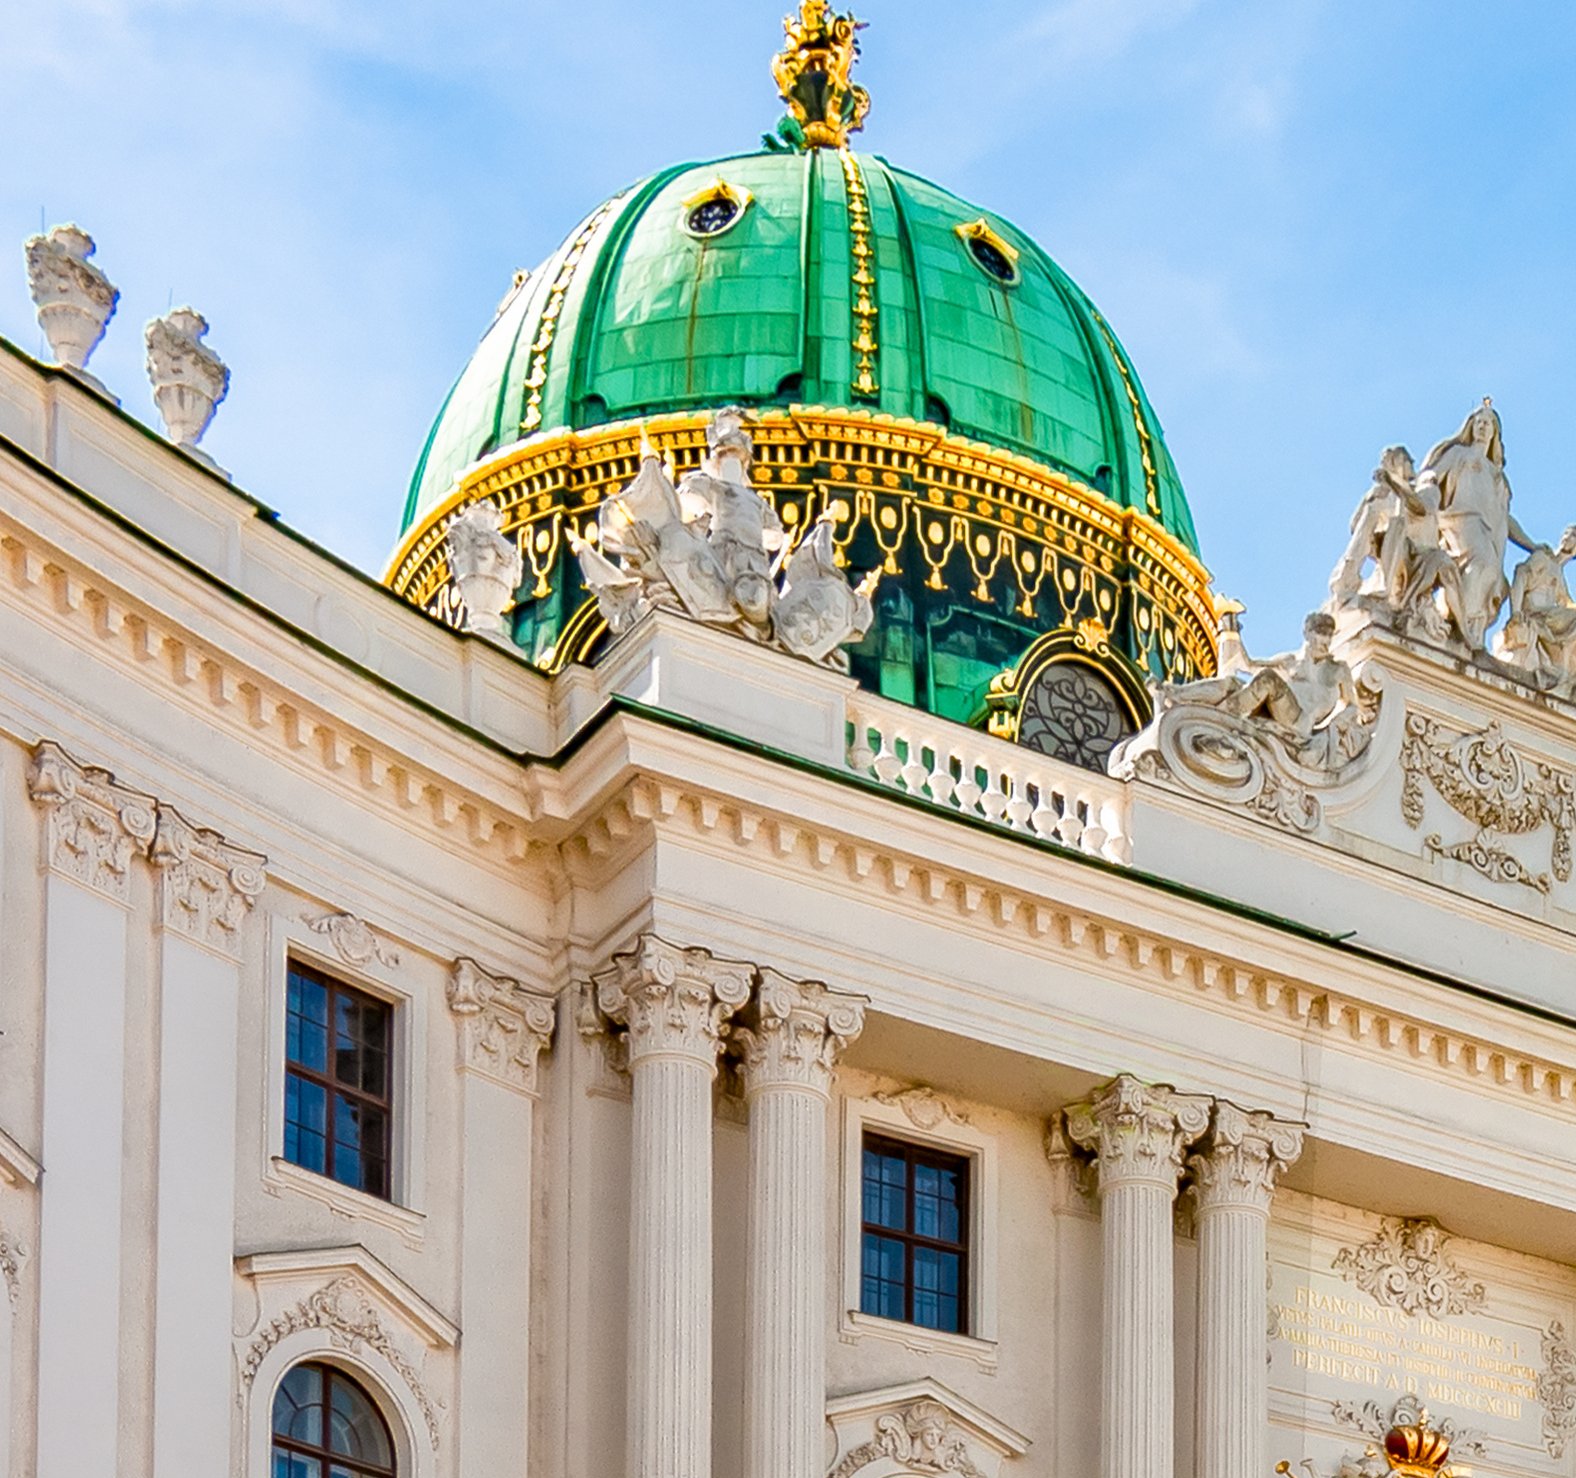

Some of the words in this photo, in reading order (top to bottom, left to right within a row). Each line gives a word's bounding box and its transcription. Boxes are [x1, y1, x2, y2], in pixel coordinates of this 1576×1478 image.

[1296, 1287, 1408, 1331] FRANCISCVS
[1419, 1319, 1503, 1354] IOSEPHVS
[1293, 1348, 1380, 1385] PERFECIT
